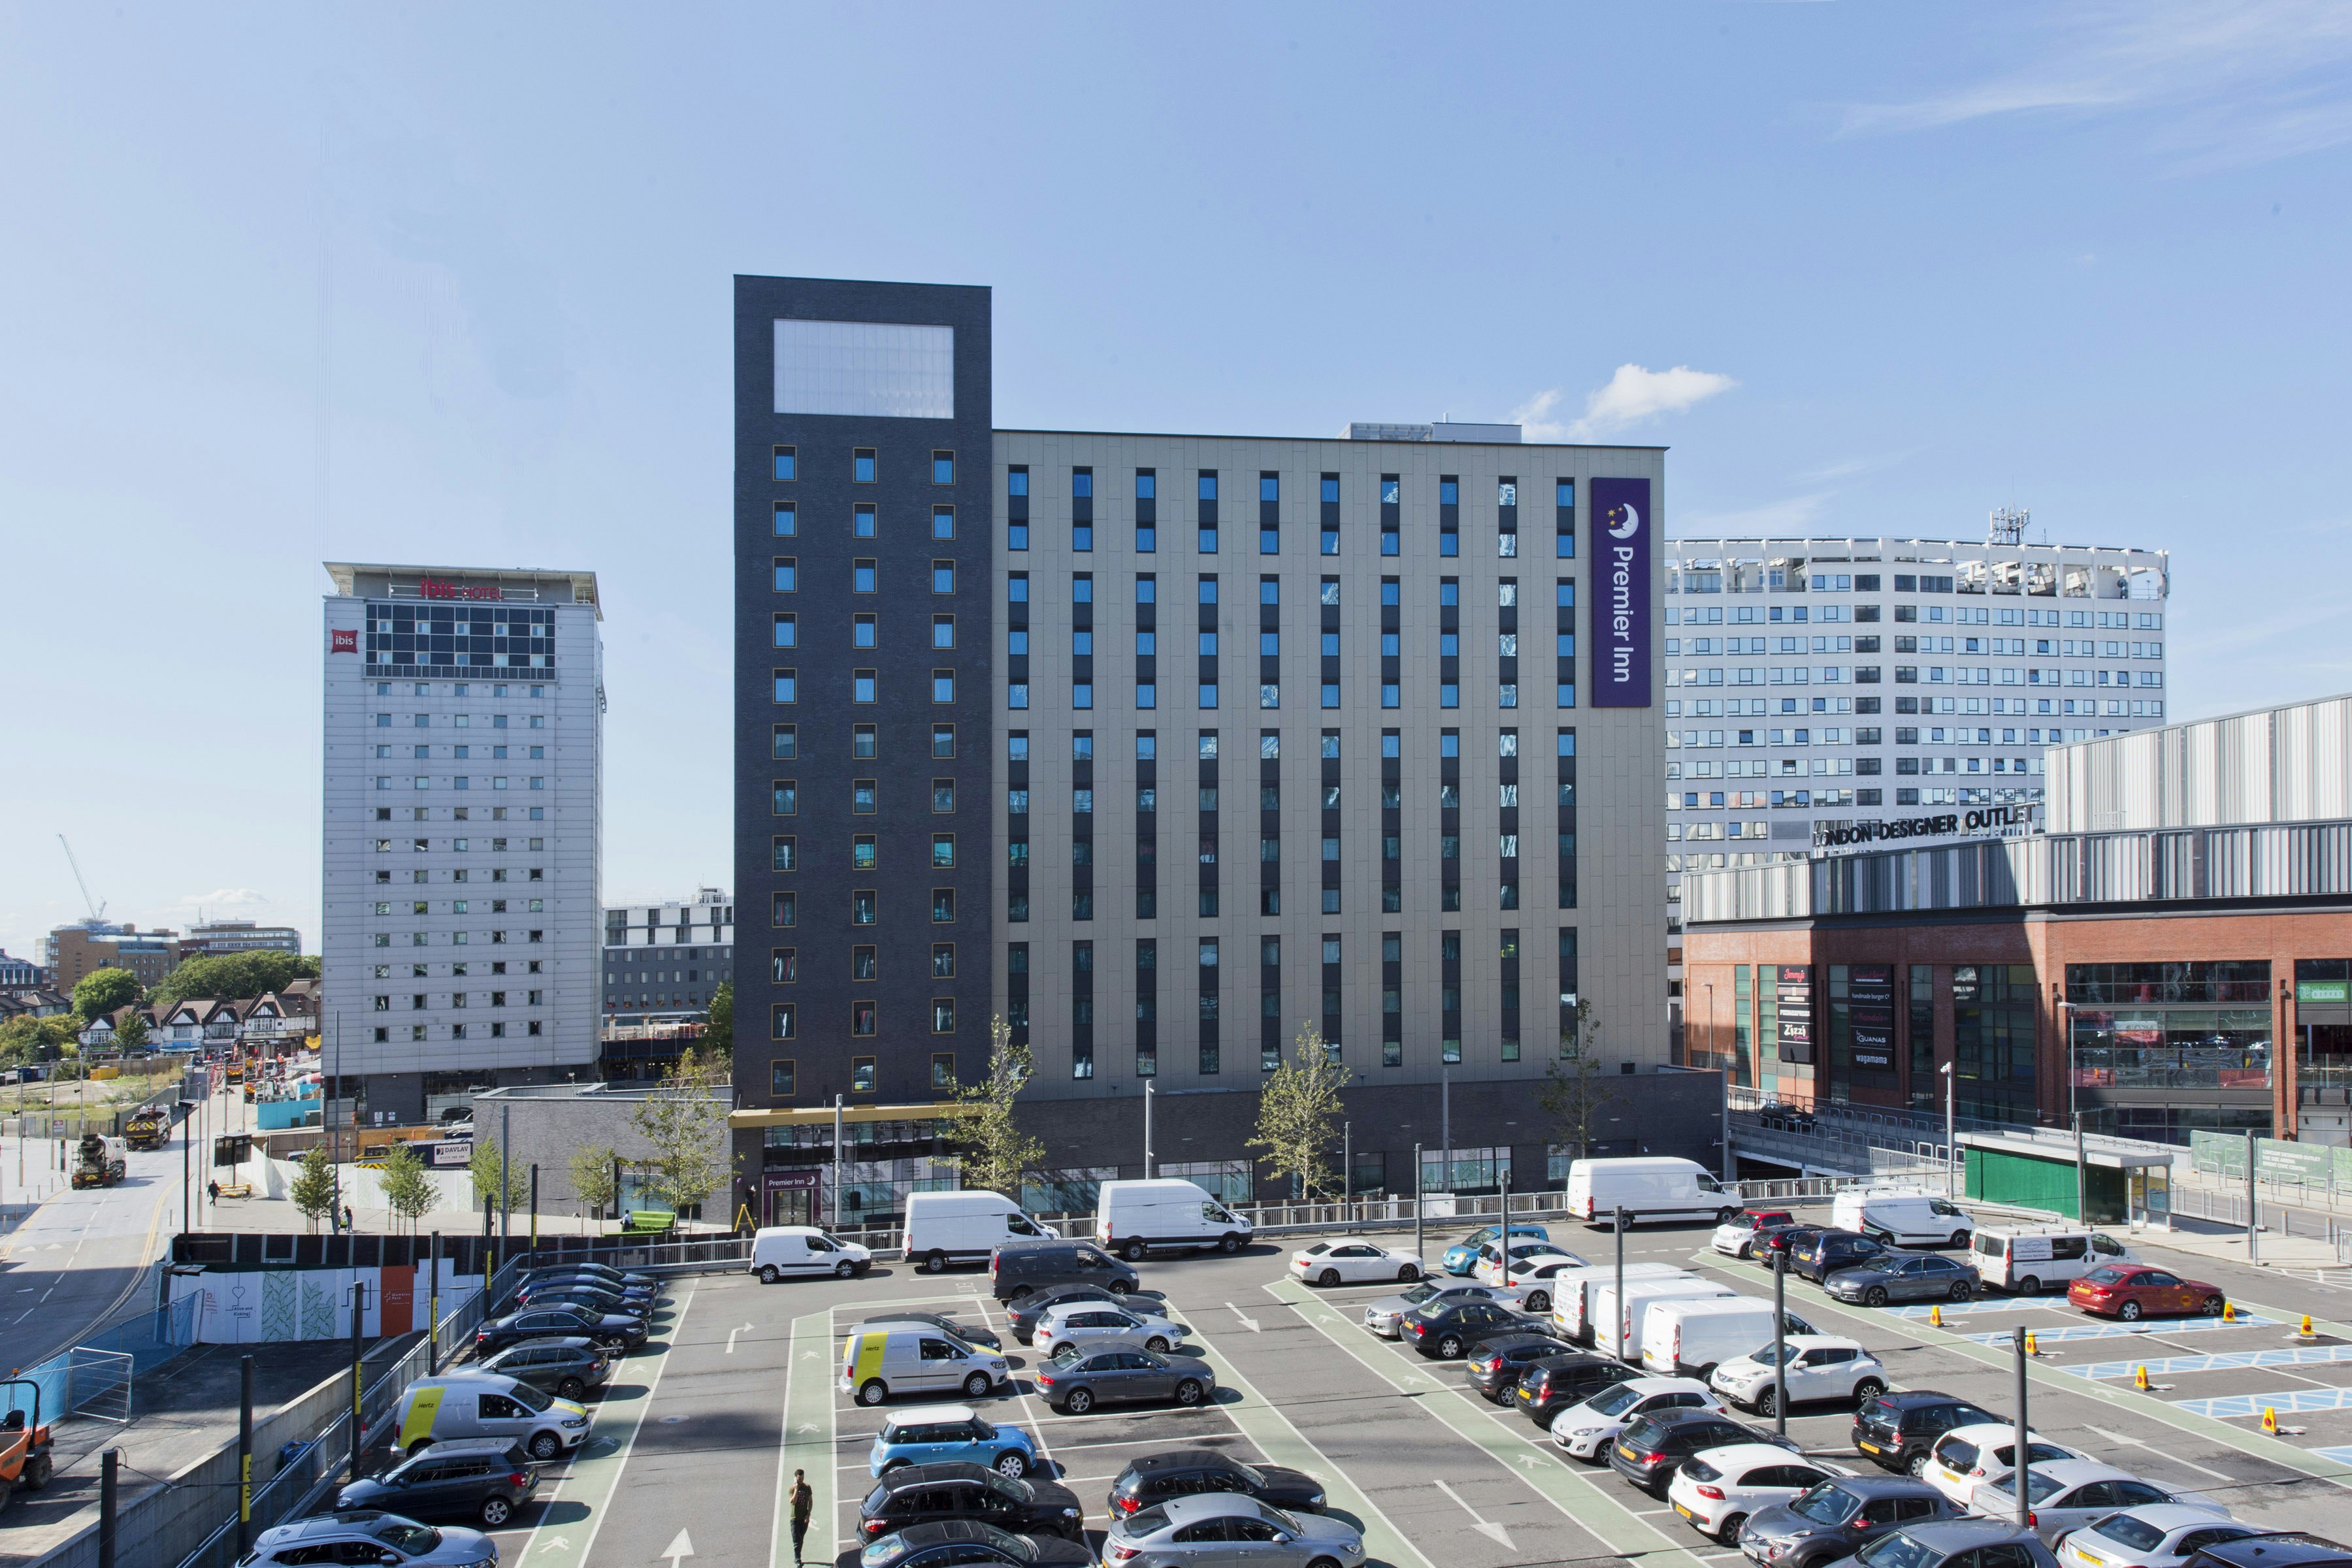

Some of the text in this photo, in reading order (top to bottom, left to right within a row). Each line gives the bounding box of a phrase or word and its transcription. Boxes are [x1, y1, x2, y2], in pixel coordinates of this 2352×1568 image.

[420, 578, 504, 600] ibis HOTEL
[1613, 546, 1634, 683] Premier Inn
[335, 636, 353, 645] ibis
[1812, 802, 2038, 848] LONDON DESIGNER OUTLET
[1784, 1024, 1806, 1037] Zizzi
[1855, 1054, 1887, 1064] wagamama
